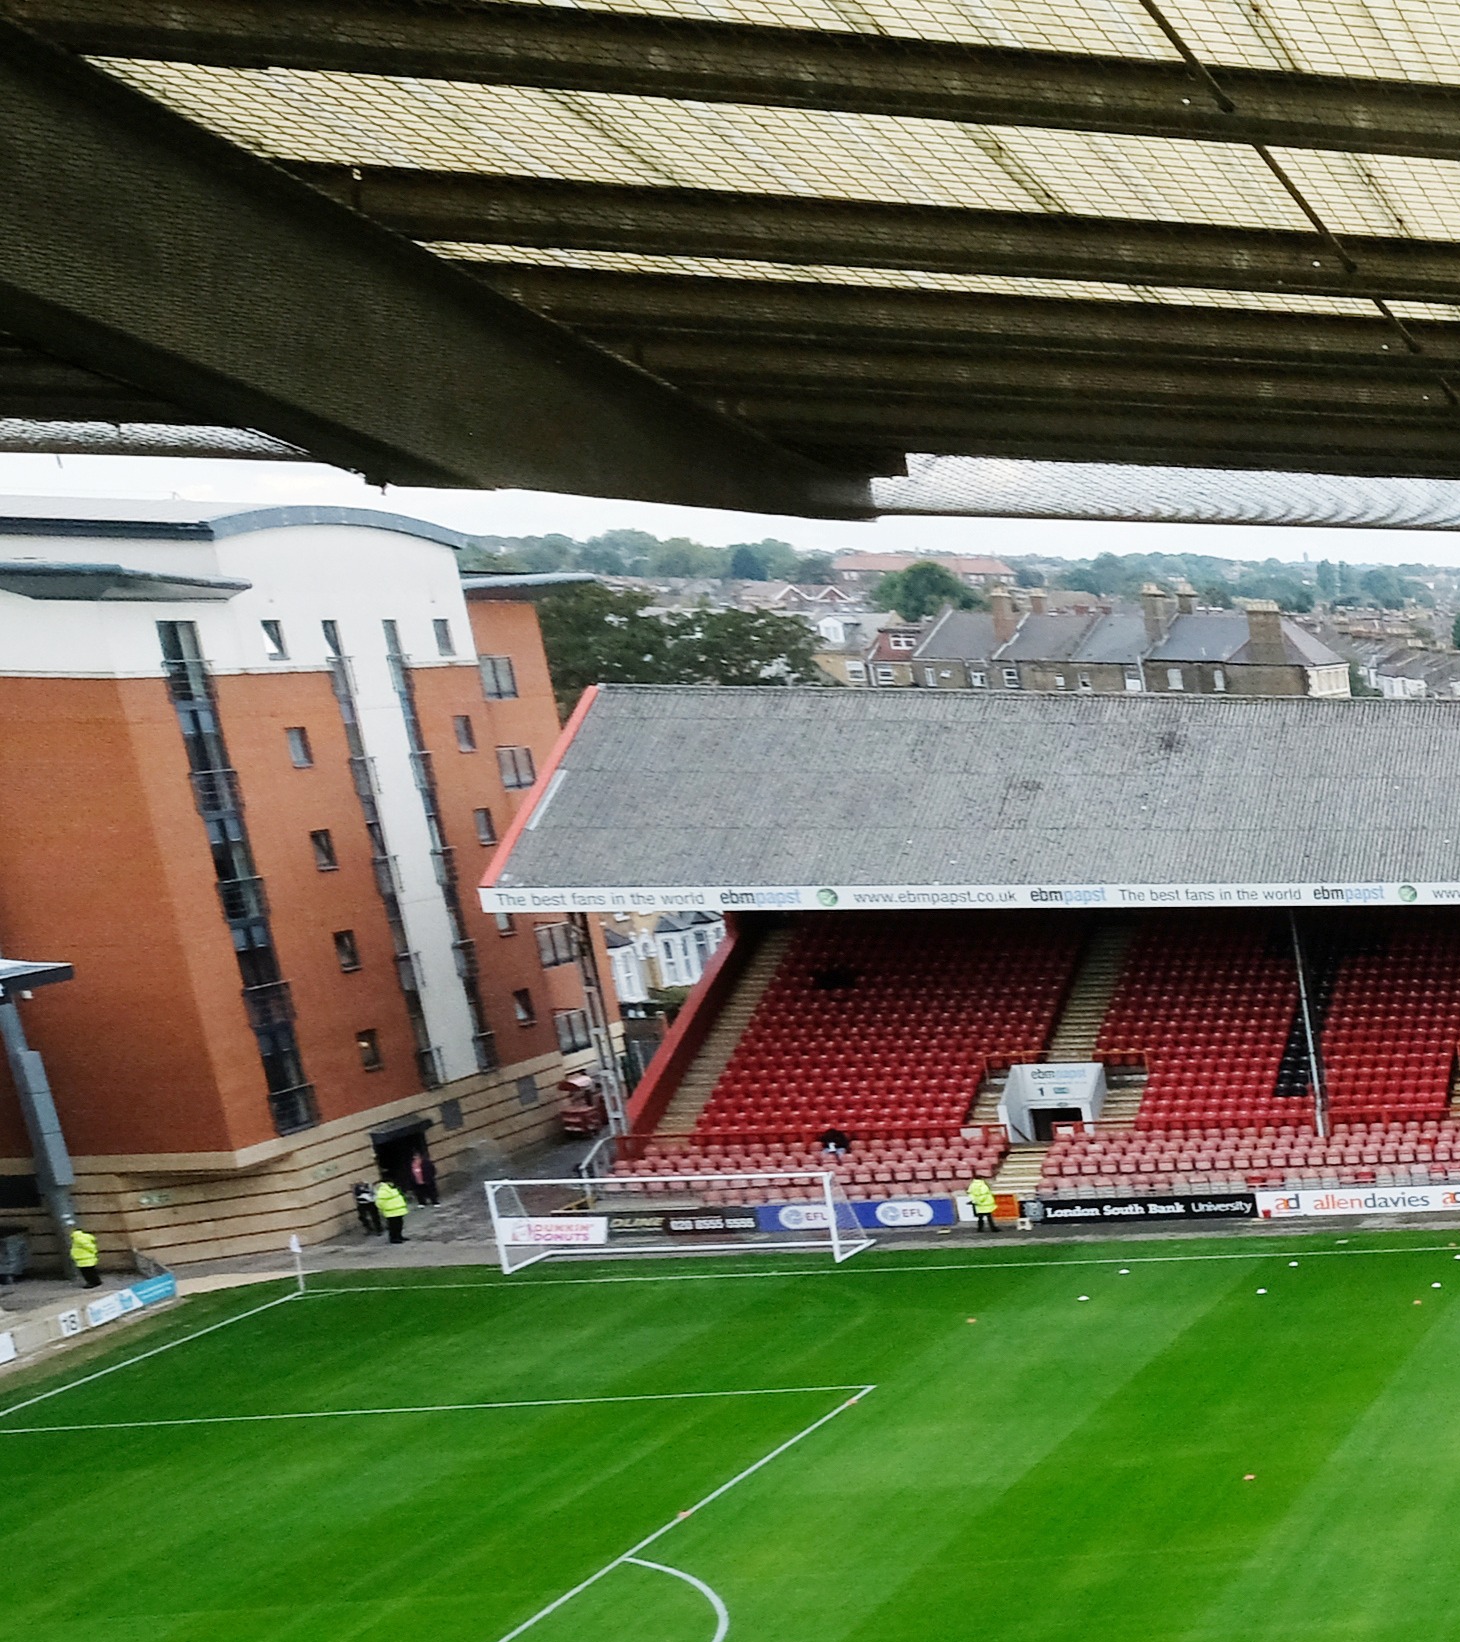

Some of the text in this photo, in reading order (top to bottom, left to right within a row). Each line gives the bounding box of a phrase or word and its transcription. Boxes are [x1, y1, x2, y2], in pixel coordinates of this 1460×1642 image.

[496, 891, 706, 906] The best fans the world
[1119, 888, 1302, 902] The best fans the world
[1045, 1199, 1253, 1219] London South Bank University
[1313, 1192, 1430, 1211] allendavies
[901, 1205, 925, 1218] EFL
